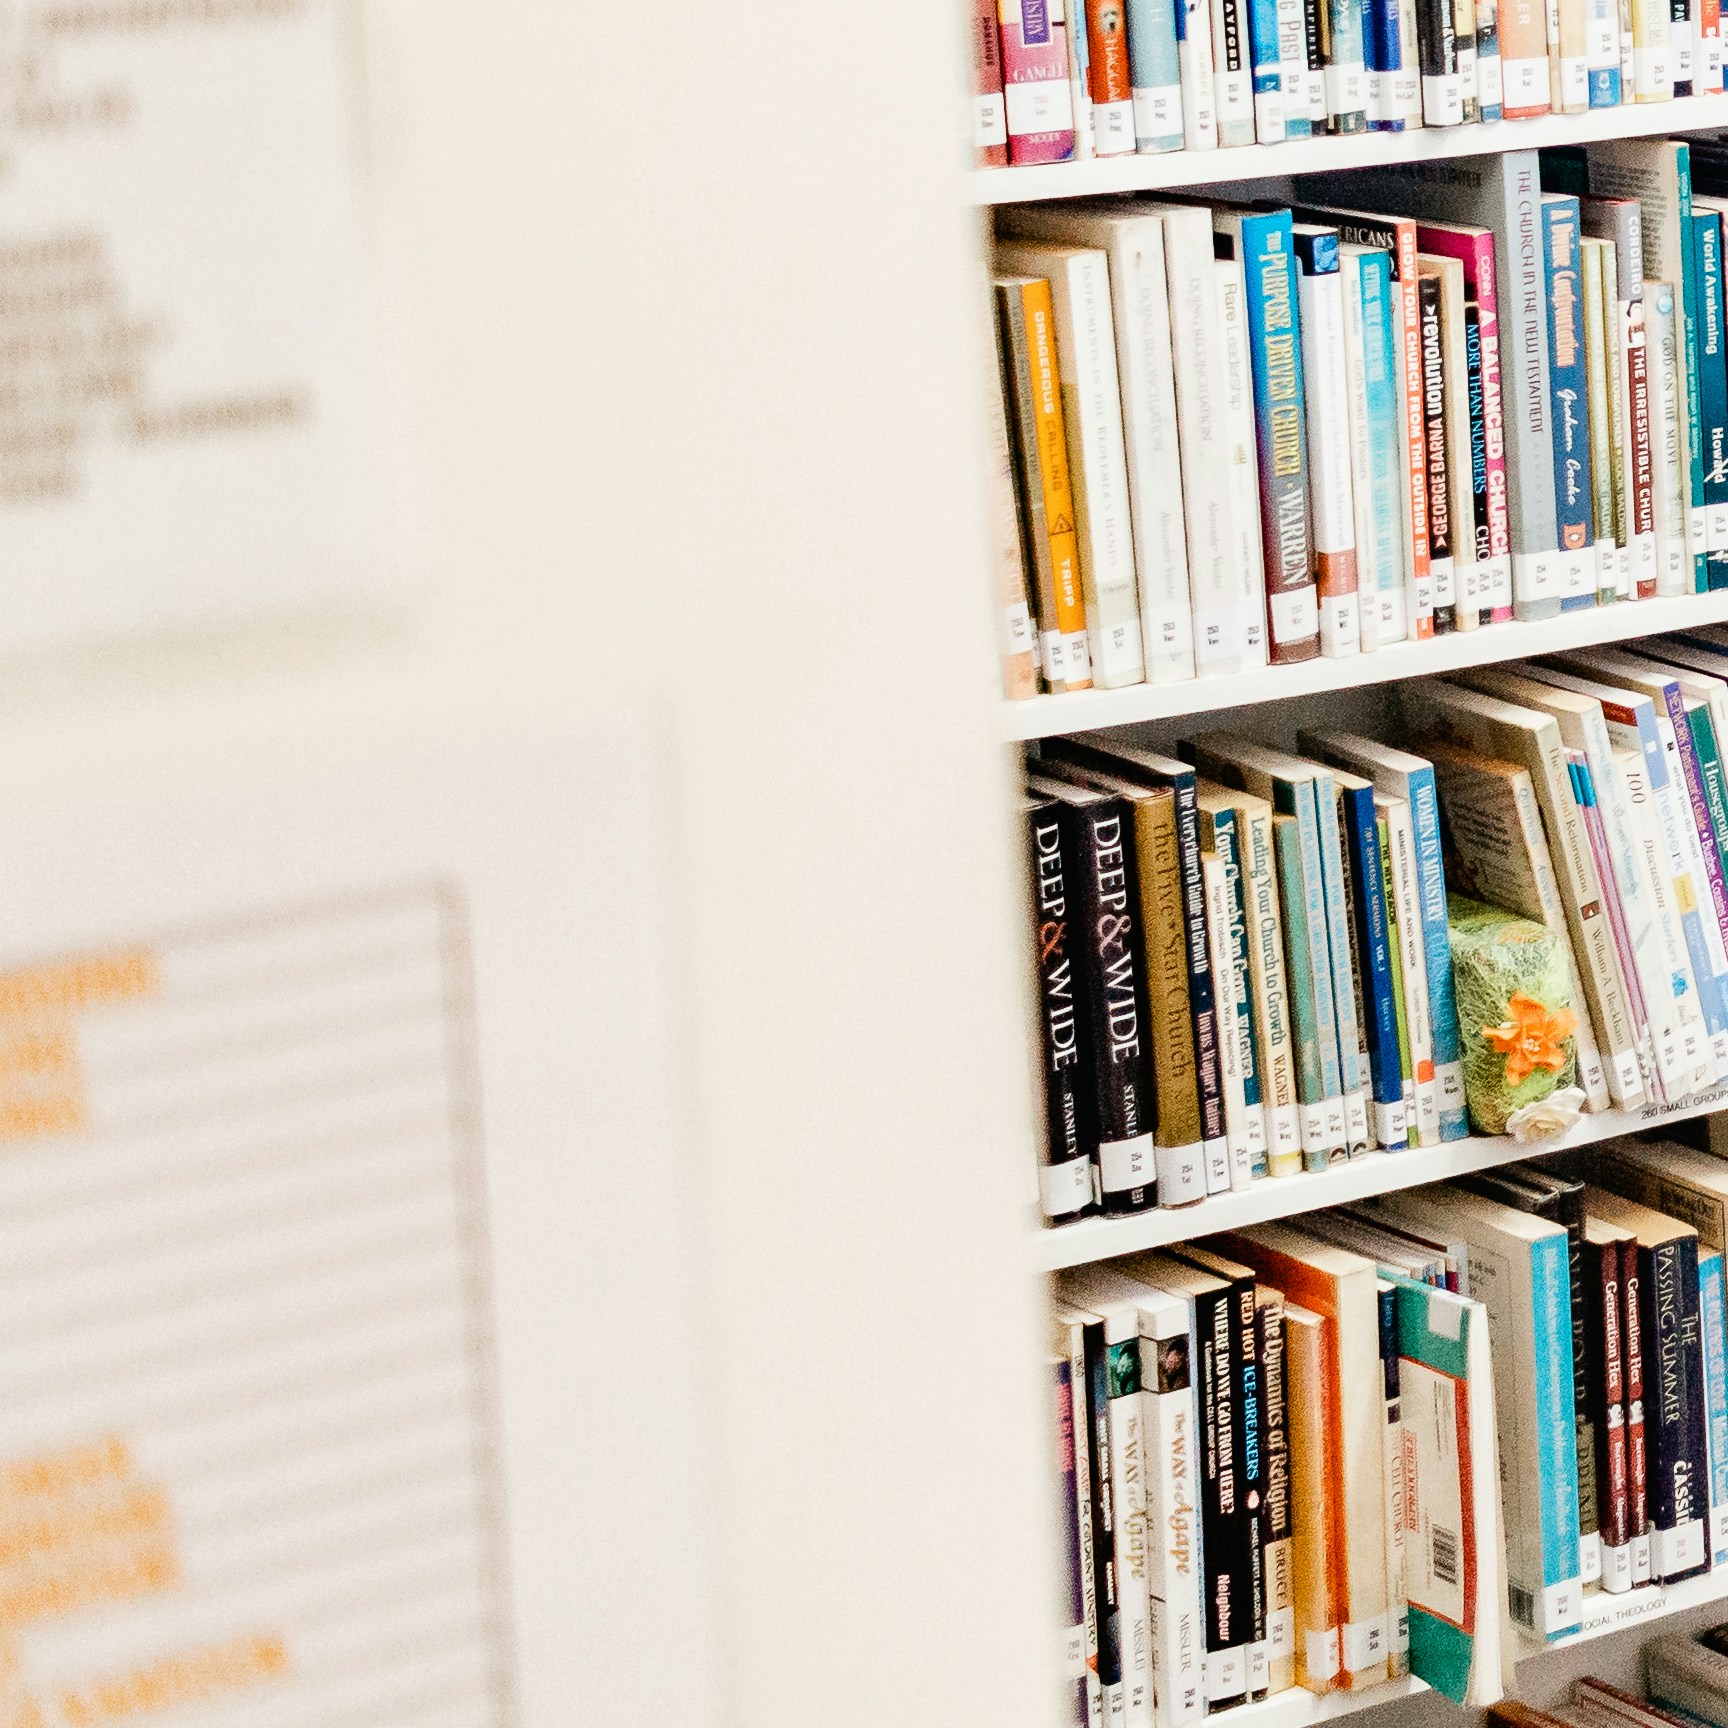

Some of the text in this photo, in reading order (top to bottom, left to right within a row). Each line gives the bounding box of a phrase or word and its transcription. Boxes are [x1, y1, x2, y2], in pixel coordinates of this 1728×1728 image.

[1627, 216, 1641, 296] CORDEIRO
[1704, 229, 1718, 356] World Awakening
[1033, 311, 1055, 414] DANGEROUS
[1423, 315, 1444, 415] revolution
[1258, 252, 1309, 585] PURPOSE DRIVEN CHURCH WARREN
[1430, 421, 1449, 537] GEORGE BARNA
[1060, 558, 1074, 607] TRIPP
[1250, 814, 1269, 874] Leading
[1093, 815, 1139, 1064] DEEP & WIDE
[1257, 875, 1273, 916] Your
[1036, 823, 1077, 1072] DEEP & WIDE
[1260, 919, 1277, 970] Church
[1267, 989, 1285, 1047] Growth
[1640, 1106, 1658, 1120] 260
[1660, 1096, 1692, 1115] SMALL
[1240, 1291, 1259, 1481] RED HOT ICE-BREAKERS
[1616, 1598, 1668, 1624] THEOLOGY
